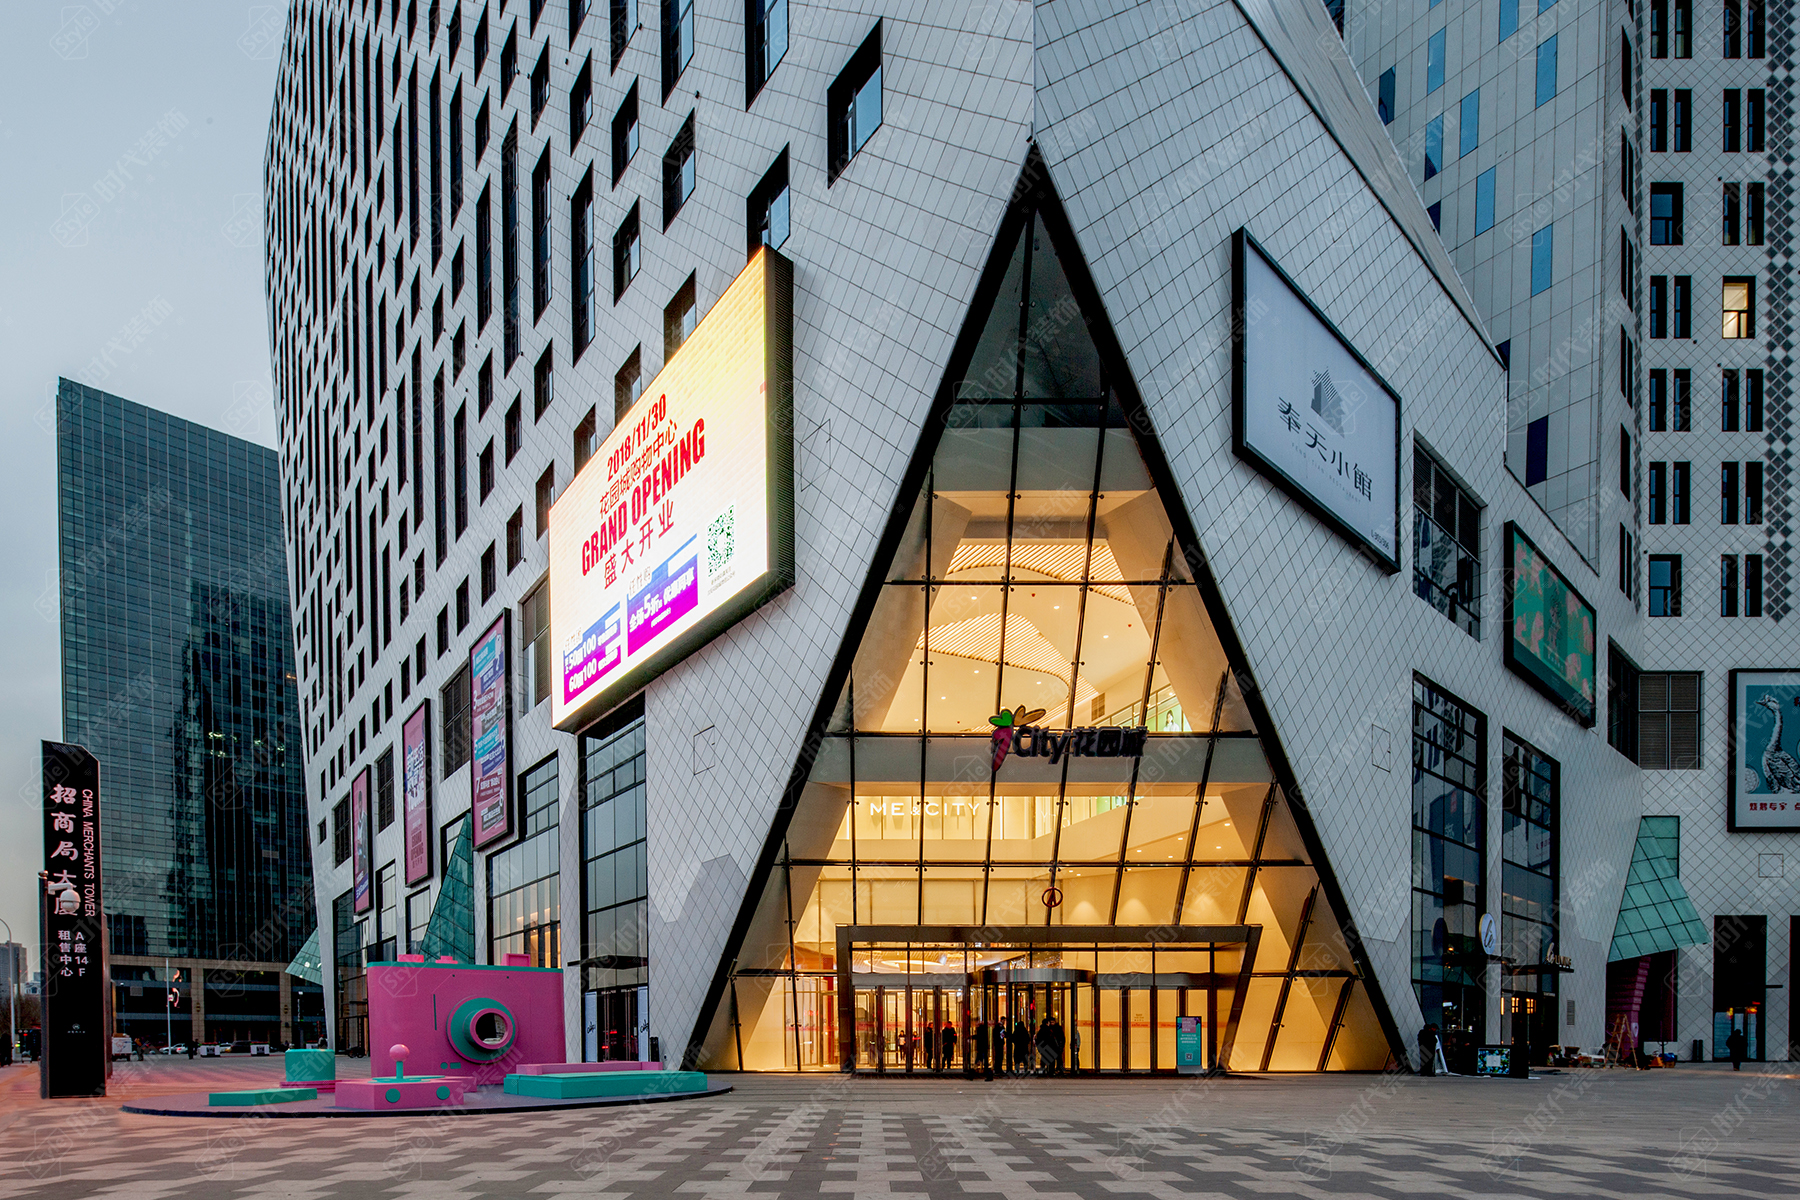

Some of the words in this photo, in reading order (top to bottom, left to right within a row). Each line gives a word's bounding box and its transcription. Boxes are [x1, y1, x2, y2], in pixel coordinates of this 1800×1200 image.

[600, 418, 678, 519] 花园城购物中心
[607, 393, 666, 482] 2018/11/30
[1278, 396, 1373, 502] 奉天小館
[582, 501, 627, 576] GRAND
[632, 418, 705, 526] OPENING
[604, 499, 674, 590] 盛大开业
[1013, 725, 1071, 764] City
[82, 789, 93, 818] CHINA
[83, 821, 95, 880] MERCHANTS
[84, 882, 96, 917] TOWER
[58, 930, 73, 977] 租售中心
